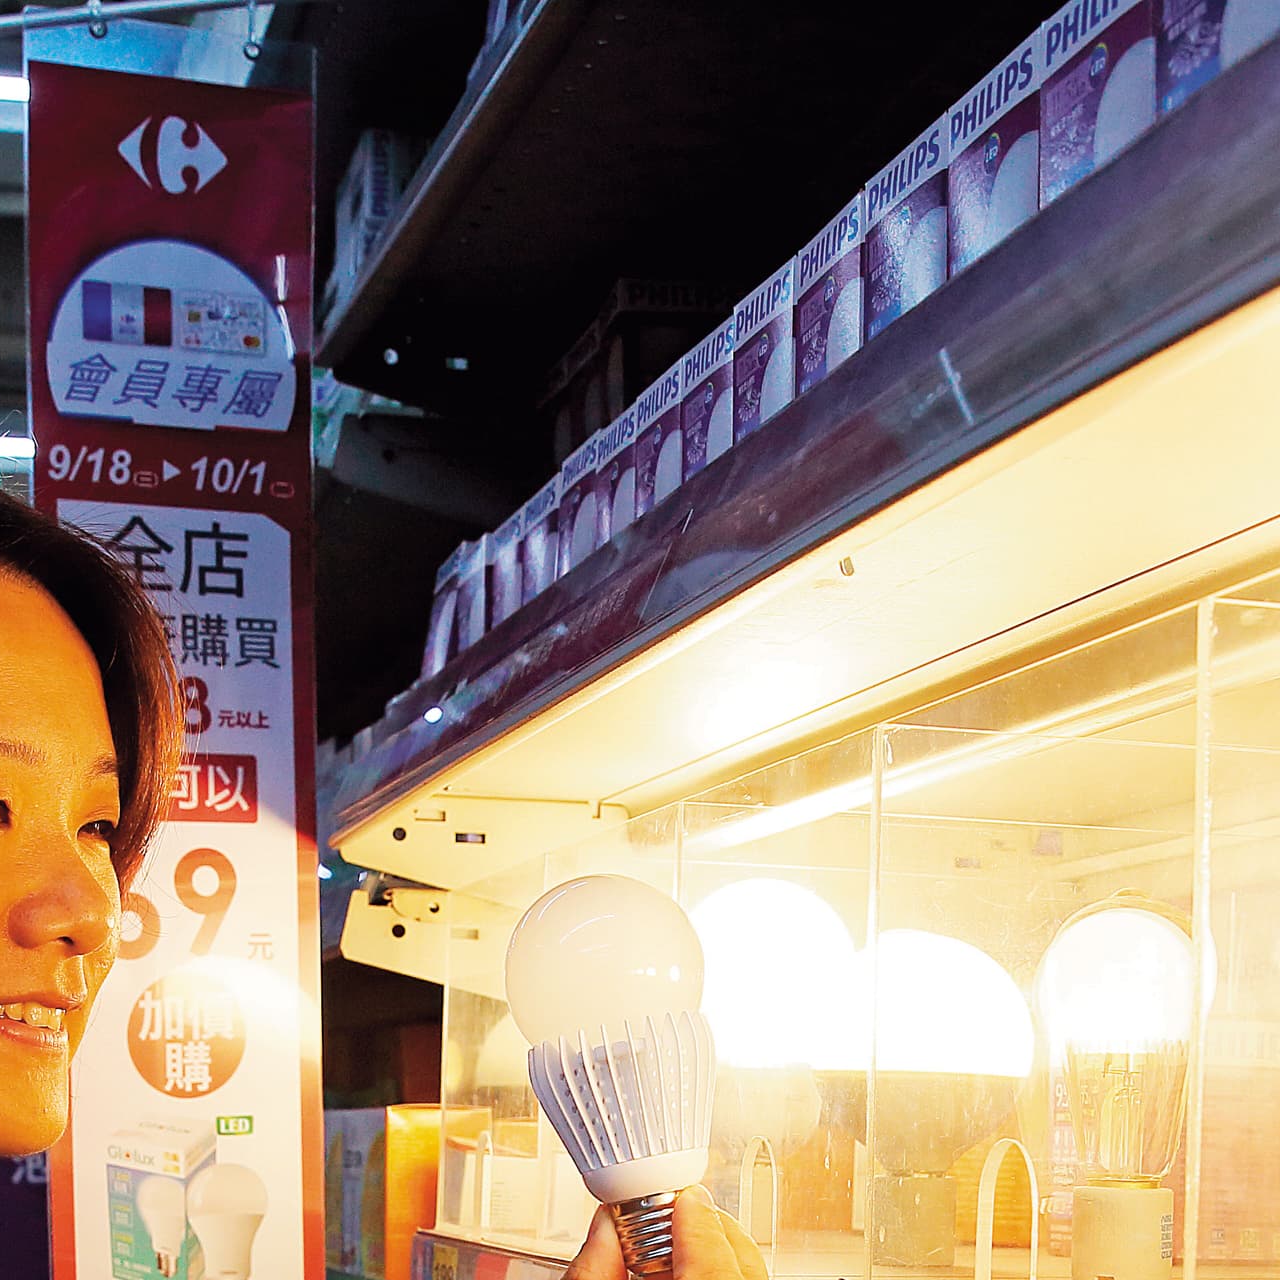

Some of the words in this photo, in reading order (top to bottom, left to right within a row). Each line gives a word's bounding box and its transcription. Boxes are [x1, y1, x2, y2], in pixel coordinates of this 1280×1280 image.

[1046, 0, 1118, 67] PHIL
[950, 47, 1033, 150] PHILIPS
[869, 129, 940, 219] PHILIPS
[984, 143, 999, 164] LED
[800, 205, 859, 287] PHILIPS
[736, 269, 790, 341] PHILIPS
[685, 323, 734, 387] PHILIPS
[64, 353, 282, 418] 會員專屬
[637, 370, 679, 429] PHILIPS
[562, 439, 597, 485] PHILIPS
[597, 411, 635, 465] PHILIPS
[48, 444, 132, 485] 9/18
[190, 456, 267, 496] 10/1
[113, 515, 249, 598] 全店
[162, 613, 280, 669] 購買
[218, 709, 270, 729] 元以上
[170, 764, 251, 812] 可以
[247, 932, 274, 961] 元
[138, 989, 234, 1041] 加價
[164, 1041, 213, 1092] 購
[219, 1118, 250, 1133] LED
